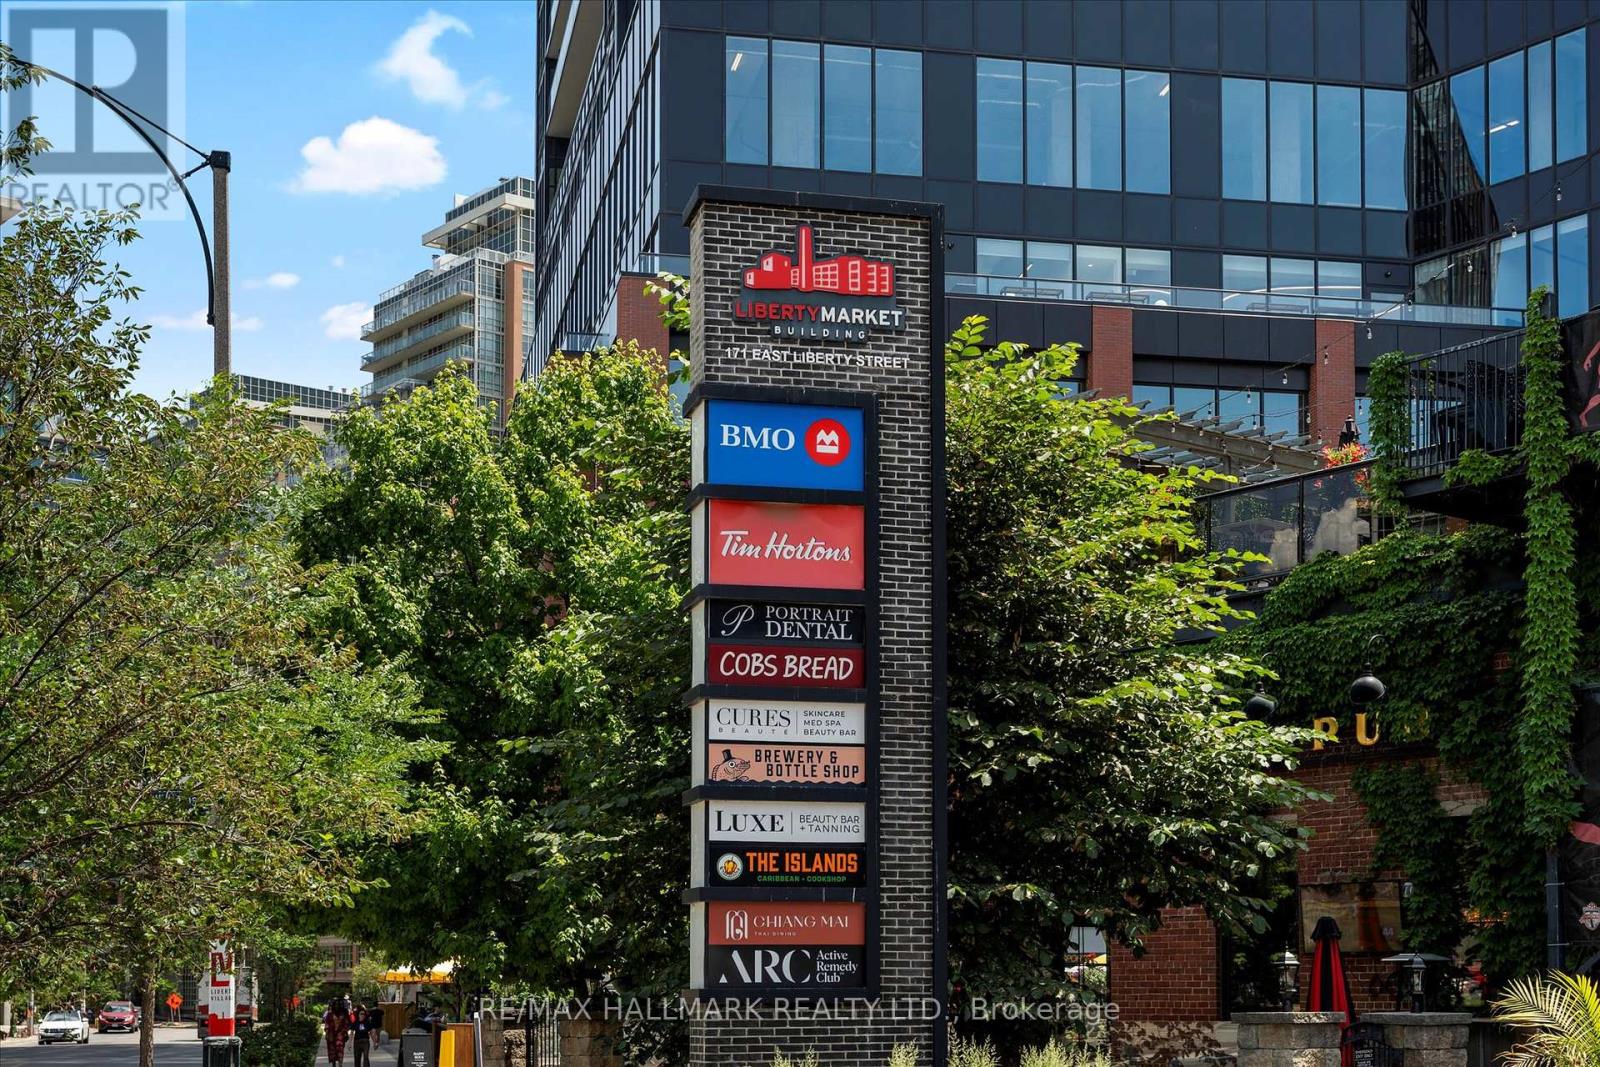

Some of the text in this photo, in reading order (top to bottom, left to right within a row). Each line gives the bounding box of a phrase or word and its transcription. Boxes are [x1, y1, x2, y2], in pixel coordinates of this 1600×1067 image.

[774, 325, 867, 339] BUILDING
[725, 347, 910, 369] 171 EAST LIBERTY STREET
[720, 424, 796, 450] BMO
[720, 530, 852, 562] Tim Hortons
[766, 605, 853, 622] PORTRAIT
[765, 620, 853, 640] DENTAL
[719, 651, 854, 681] COBS BREAD
[716, 707, 791, 728] CURES
[803, 710, 846, 718] SKINCARE
[803, 728, 836, 736] BEAUTY
[755, 749, 838, 764] BREWERY &
[766, 764, 859, 778] BOTTLE SHOP
[715, 810, 784, 833] LUXE
[799, 815, 860, 824] BEAUTY BAR
[809, 825, 860, 834] TANNING
[746, 852, 858, 873] THE ISLANDS
[753, 915, 849, 928] CHIANG MAI
[816, 950, 848, 960] Active
[718, 949, 811, 984] ARC
[816, 961, 858, 974] Remedy
